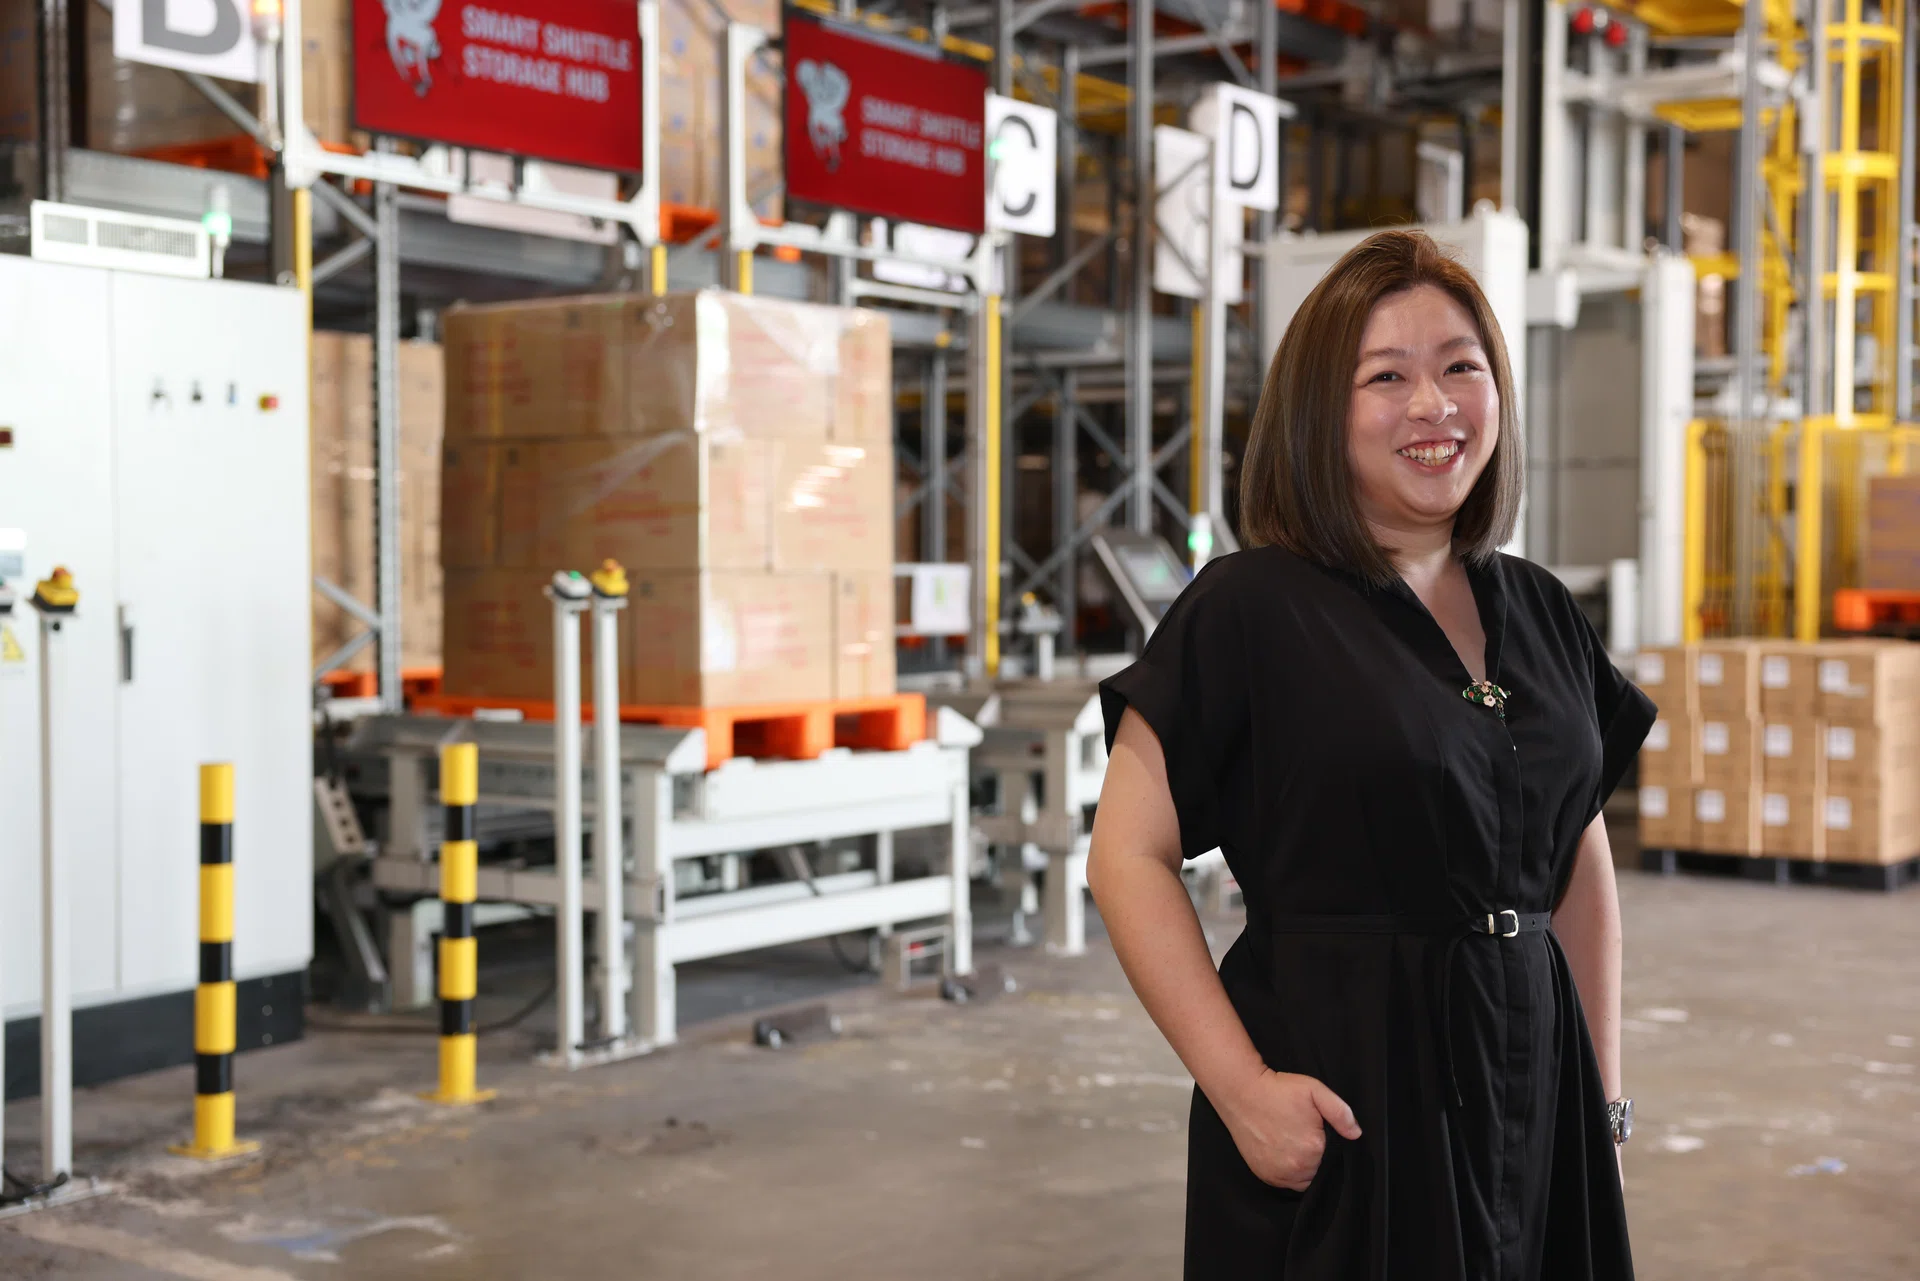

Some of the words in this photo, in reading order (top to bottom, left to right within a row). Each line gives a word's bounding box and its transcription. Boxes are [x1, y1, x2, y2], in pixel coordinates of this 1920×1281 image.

[462, 4, 540, 51] SMART
[543, 22, 632, 71] SHUTTLE
[462, 43, 562, 94] STORAGE
[565, 65, 609, 103] HUB
[994, 114, 1037, 218] C
[1231, 102, 1262, 190] D
